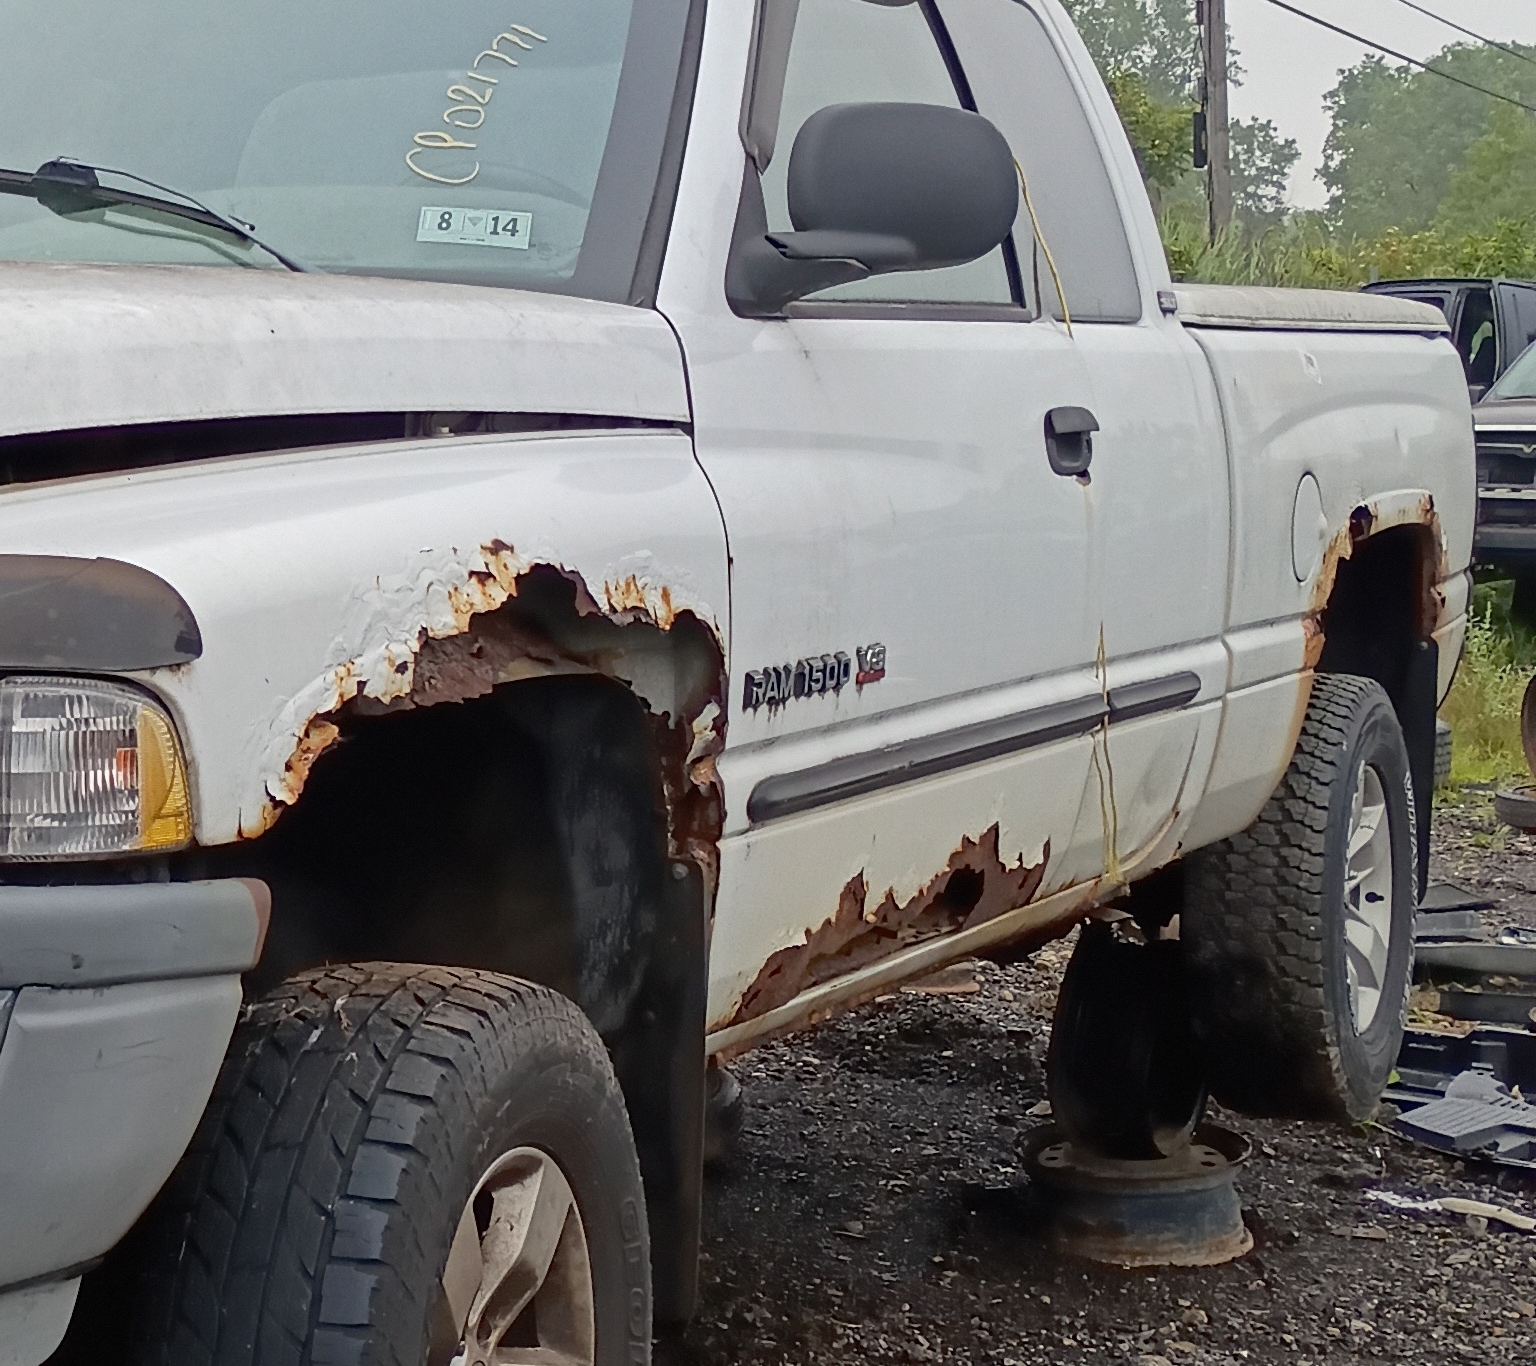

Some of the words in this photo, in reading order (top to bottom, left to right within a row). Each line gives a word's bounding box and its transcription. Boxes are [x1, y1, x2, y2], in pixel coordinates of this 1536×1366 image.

[437, 211, 453, 231] 8
[489, 215, 519, 237] 14
[745, 663, 795, 706] RAM
[797, 650, 851, 693] 1500
